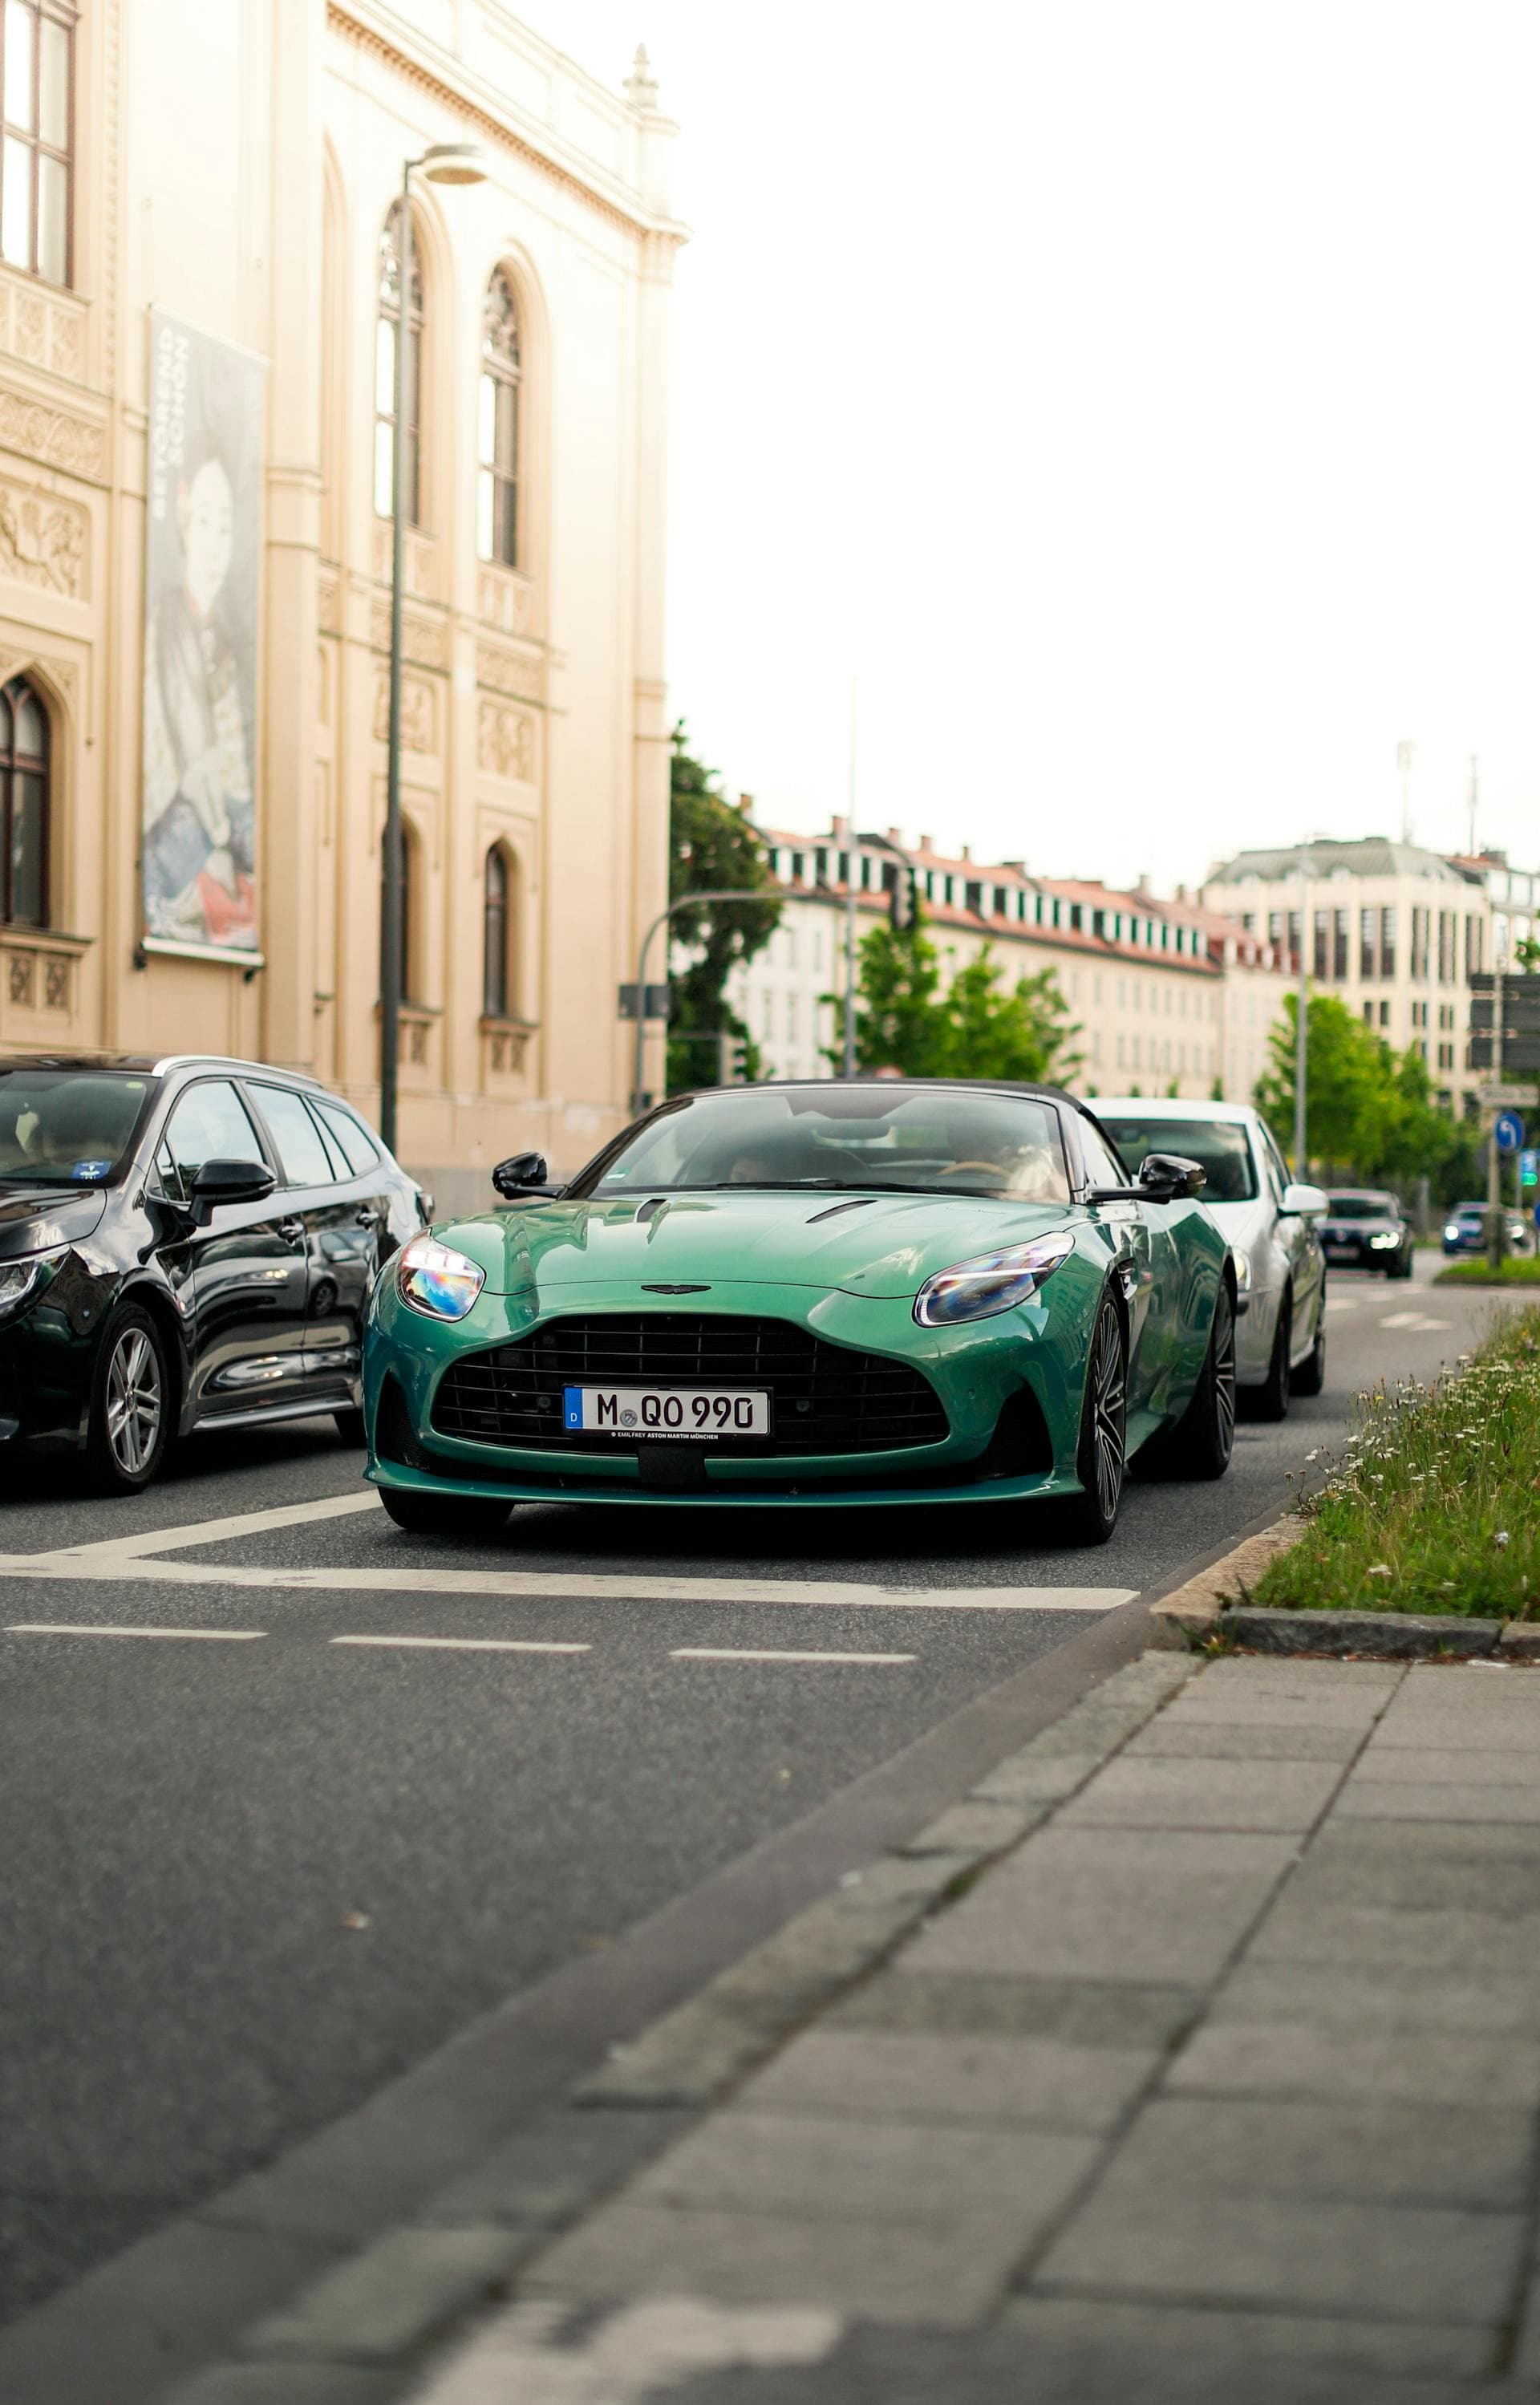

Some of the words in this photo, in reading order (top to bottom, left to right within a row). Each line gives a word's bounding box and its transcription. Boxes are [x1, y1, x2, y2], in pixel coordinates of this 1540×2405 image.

[570, 1412, 578, 1422] D
[598, 1394, 618, 1425] M
[692, 1397, 752, 1428] 990
